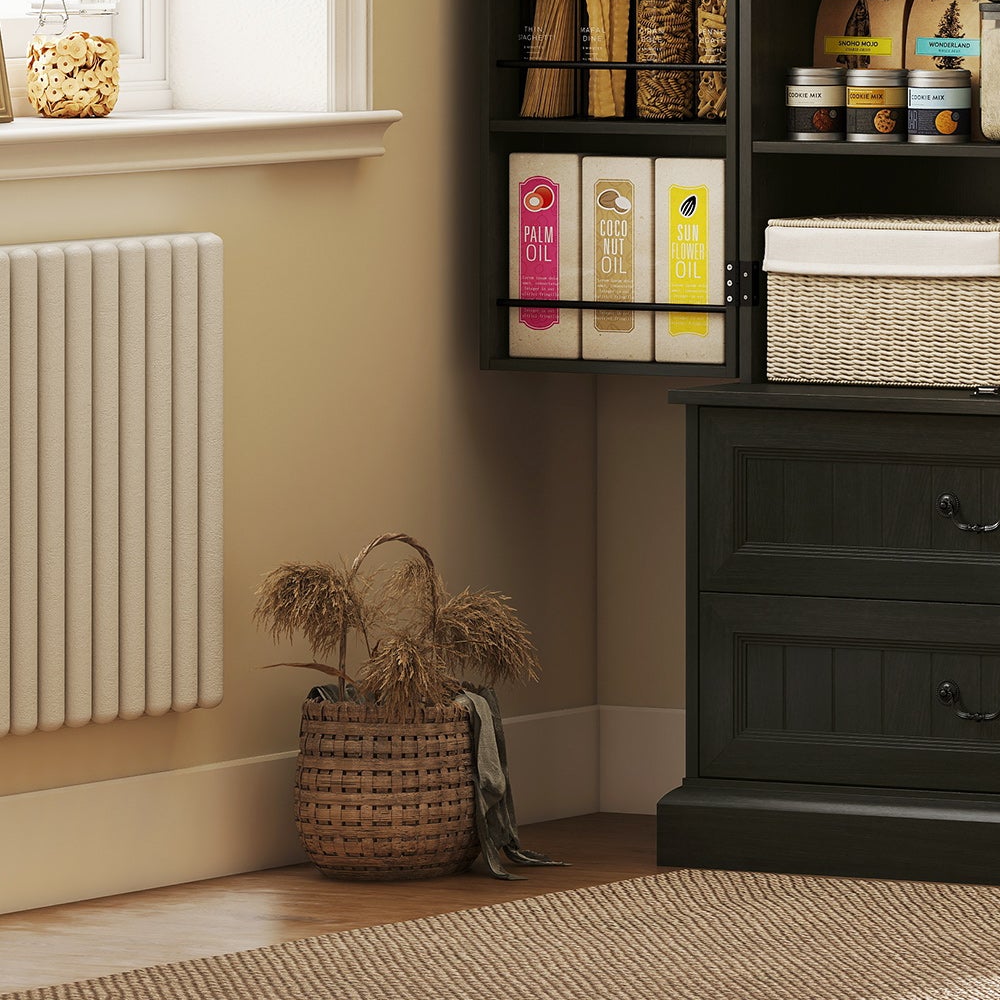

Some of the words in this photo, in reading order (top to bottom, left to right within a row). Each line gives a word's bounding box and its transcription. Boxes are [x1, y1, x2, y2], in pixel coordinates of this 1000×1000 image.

[524, 226, 553, 243] PALM
[600, 219, 627, 236] COCO
[677, 224, 699, 241] SUN
[526, 244, 552, 262] OIL
[604, 238, 624, 255] NUT
[672, 242, 704, 260] FLOWER
[602, 256, 627, 274] OIL
[675, 261, 701, 279] OIL
